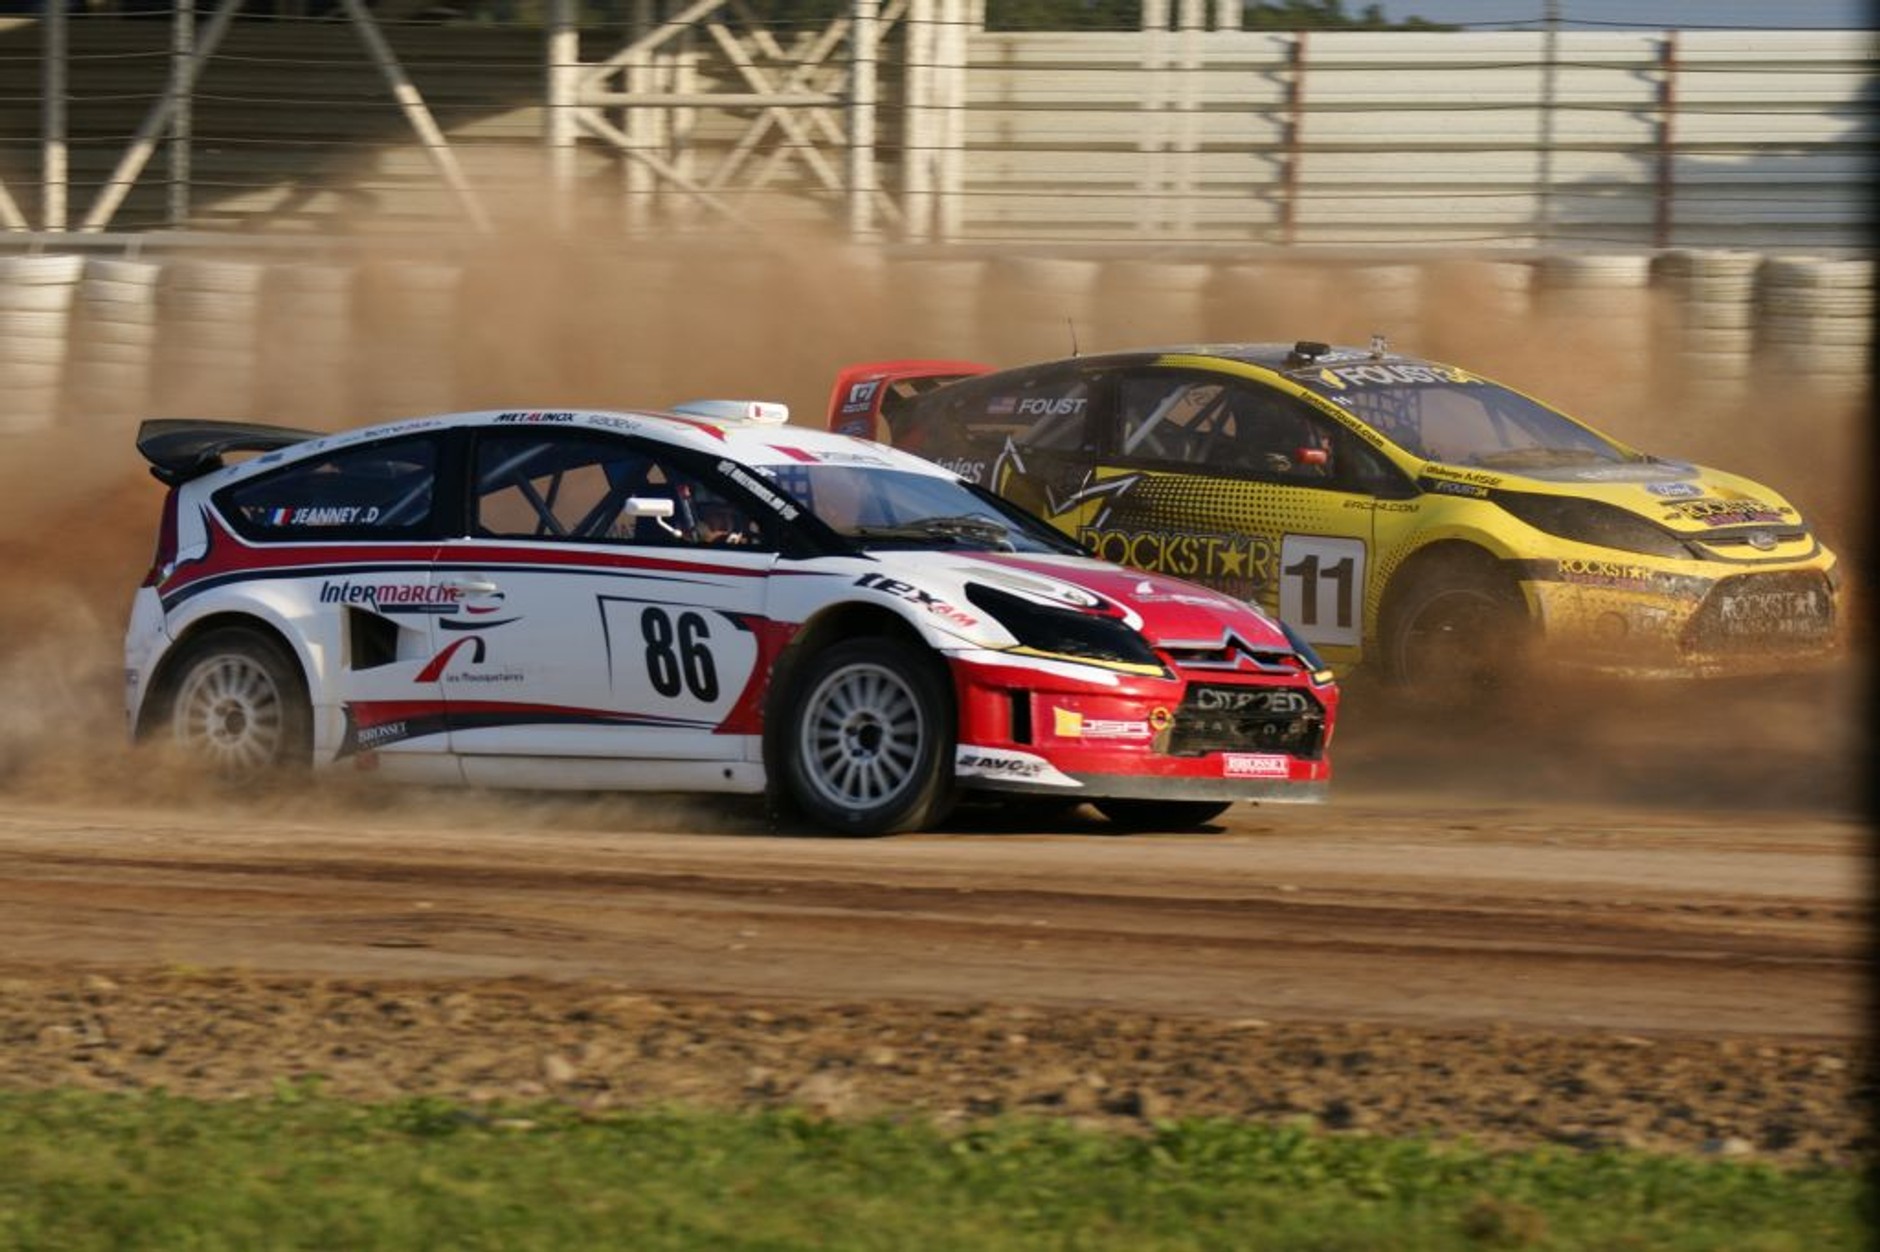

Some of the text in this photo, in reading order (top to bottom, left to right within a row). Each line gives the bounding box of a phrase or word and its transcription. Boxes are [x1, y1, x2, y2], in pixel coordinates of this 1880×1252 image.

[1018, 399, 1088, 414] FOUST
[494, 411, 576, 423] METALINOX
[291, 507, 361, 524] JEANNEY
[1285, 554, 1354, 628] 11
[641, 606, 719, 703] 86
